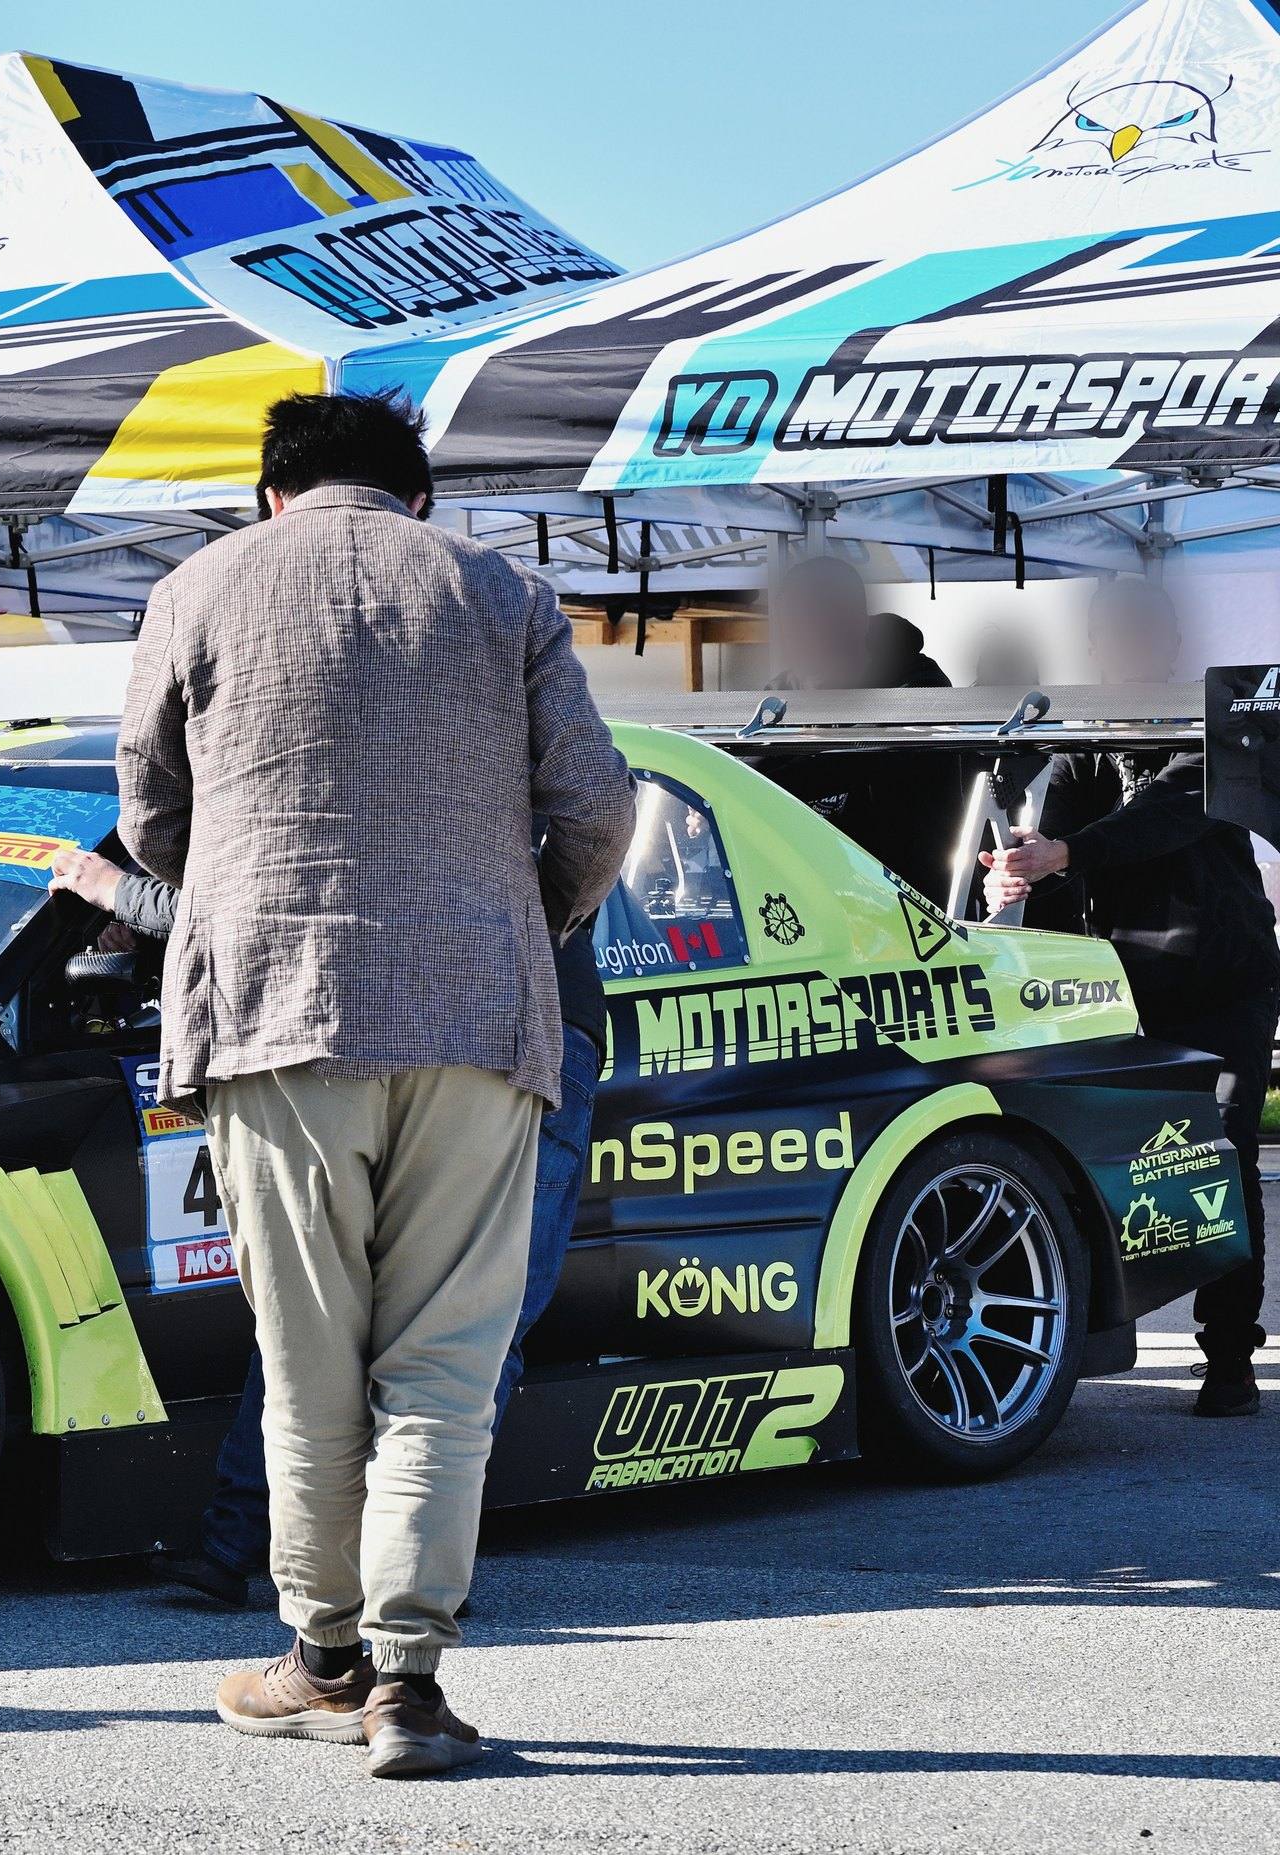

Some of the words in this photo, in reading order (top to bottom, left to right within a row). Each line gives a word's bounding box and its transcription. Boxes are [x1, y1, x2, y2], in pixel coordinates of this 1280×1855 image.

[781, 357, 1280, 443] MOTORSPOR
[1229, 702, 1252, 712] APR
[1252, 701, 1280, 712] PERF
[634, 964, 998, 1078] MOTORSPORTS
[591, 1111, 855, 1195] nSpeed
[1129, 1141, 1218, 1173] ANTIGRAVITY
[1132, 1154, 1221, 1186] BATTERIES
[1195, 1219, 1235, 1241] Valvoline
[637, 1257, 798, 1319] KÖNIG
[593, 1370, 775, 1461] UNIT
[739, 1364, 845, 1471] 2
[584, 1448, 741, 1491] FABRICATION
